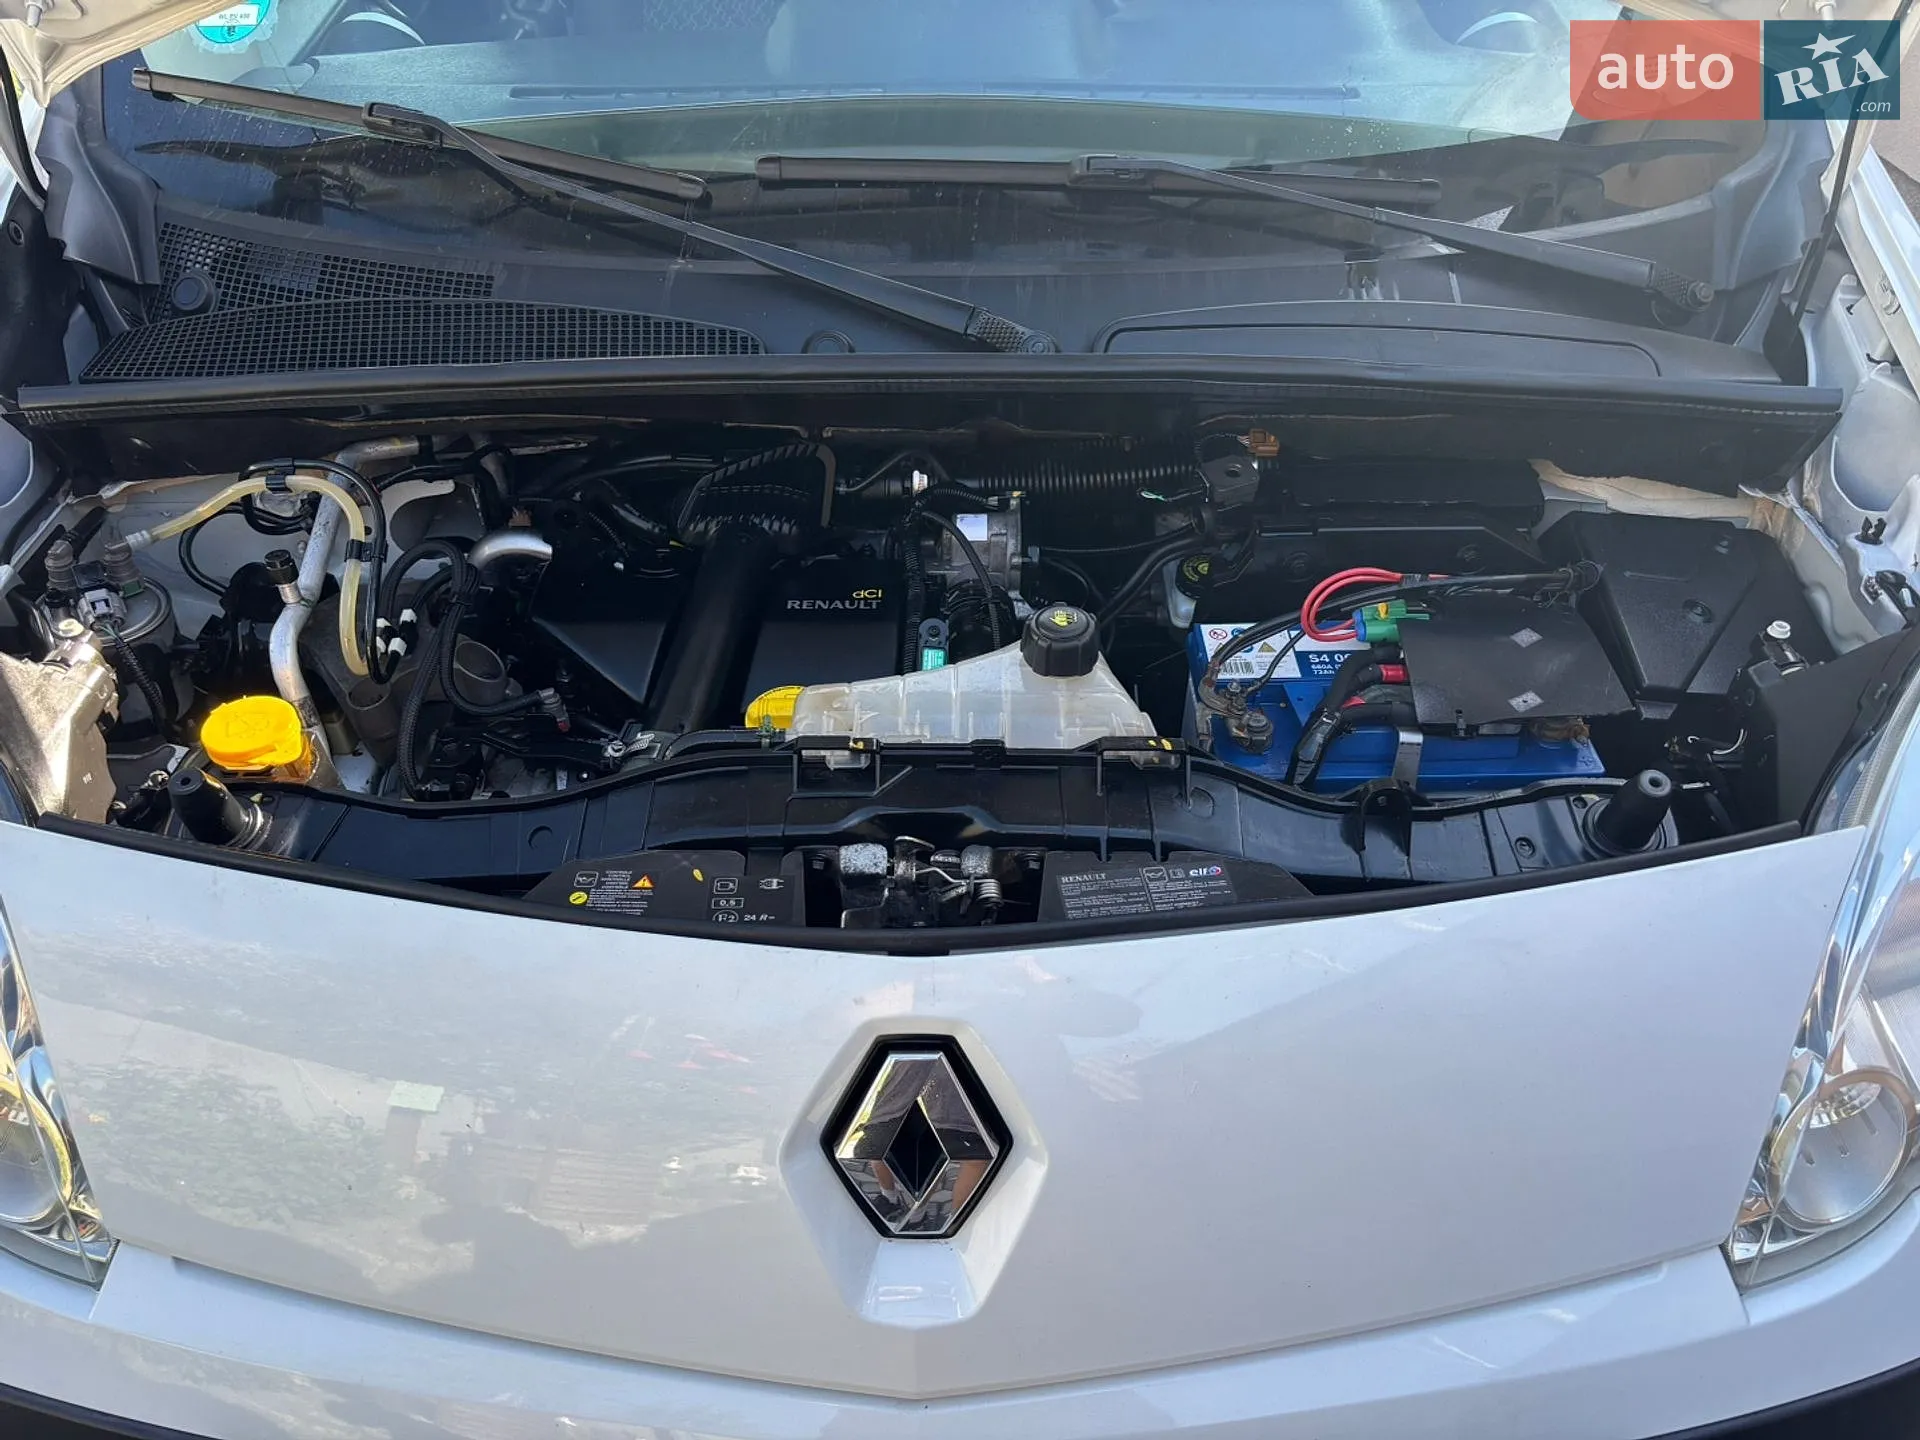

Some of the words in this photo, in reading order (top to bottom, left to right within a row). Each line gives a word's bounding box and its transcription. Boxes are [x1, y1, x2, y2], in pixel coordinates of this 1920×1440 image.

[786, 600, 882, 610] RENAULT
[1308, 653, 1330, 663] S4
[1189, 867, 1208, 876] elf
[1061, 872, 1106, 884] RENAULT
